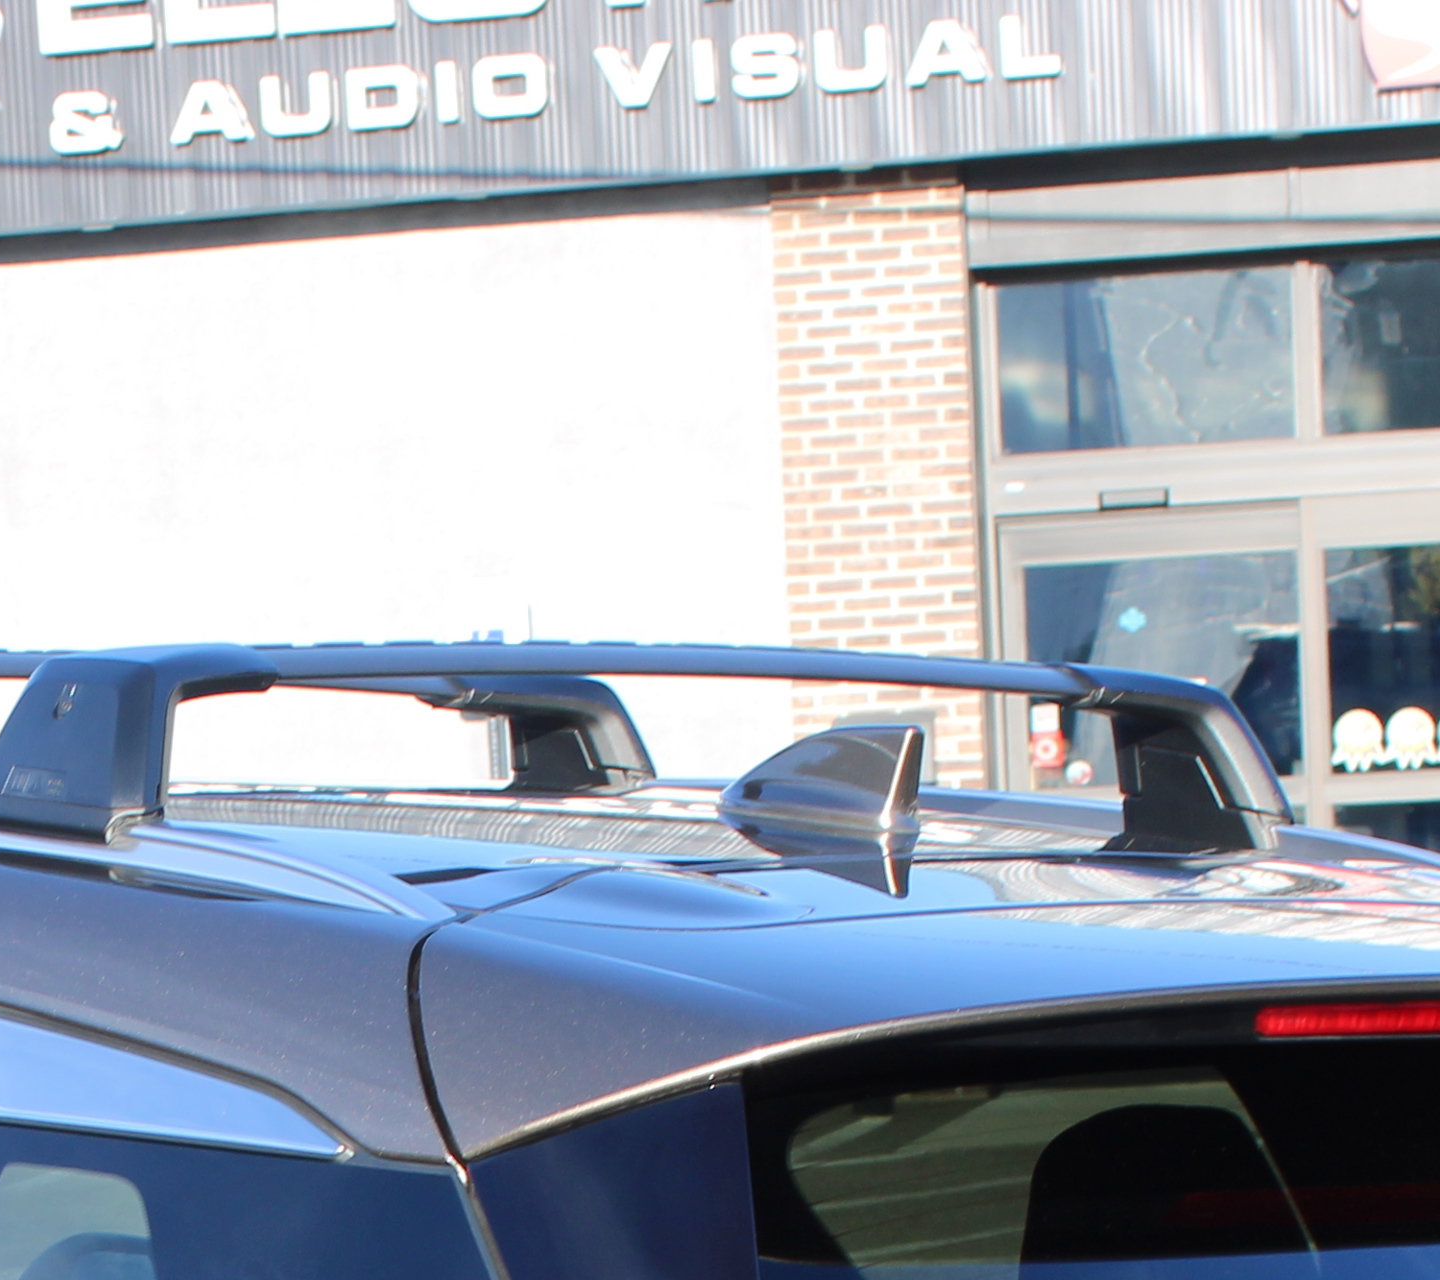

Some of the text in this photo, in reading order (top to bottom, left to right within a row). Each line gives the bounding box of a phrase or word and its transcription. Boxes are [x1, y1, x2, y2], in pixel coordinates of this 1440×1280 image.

[49, 89, 124, 156] &
[169, 51, 551, 147] AUDIO
[593, 14, 1063, 109] VISUAL
